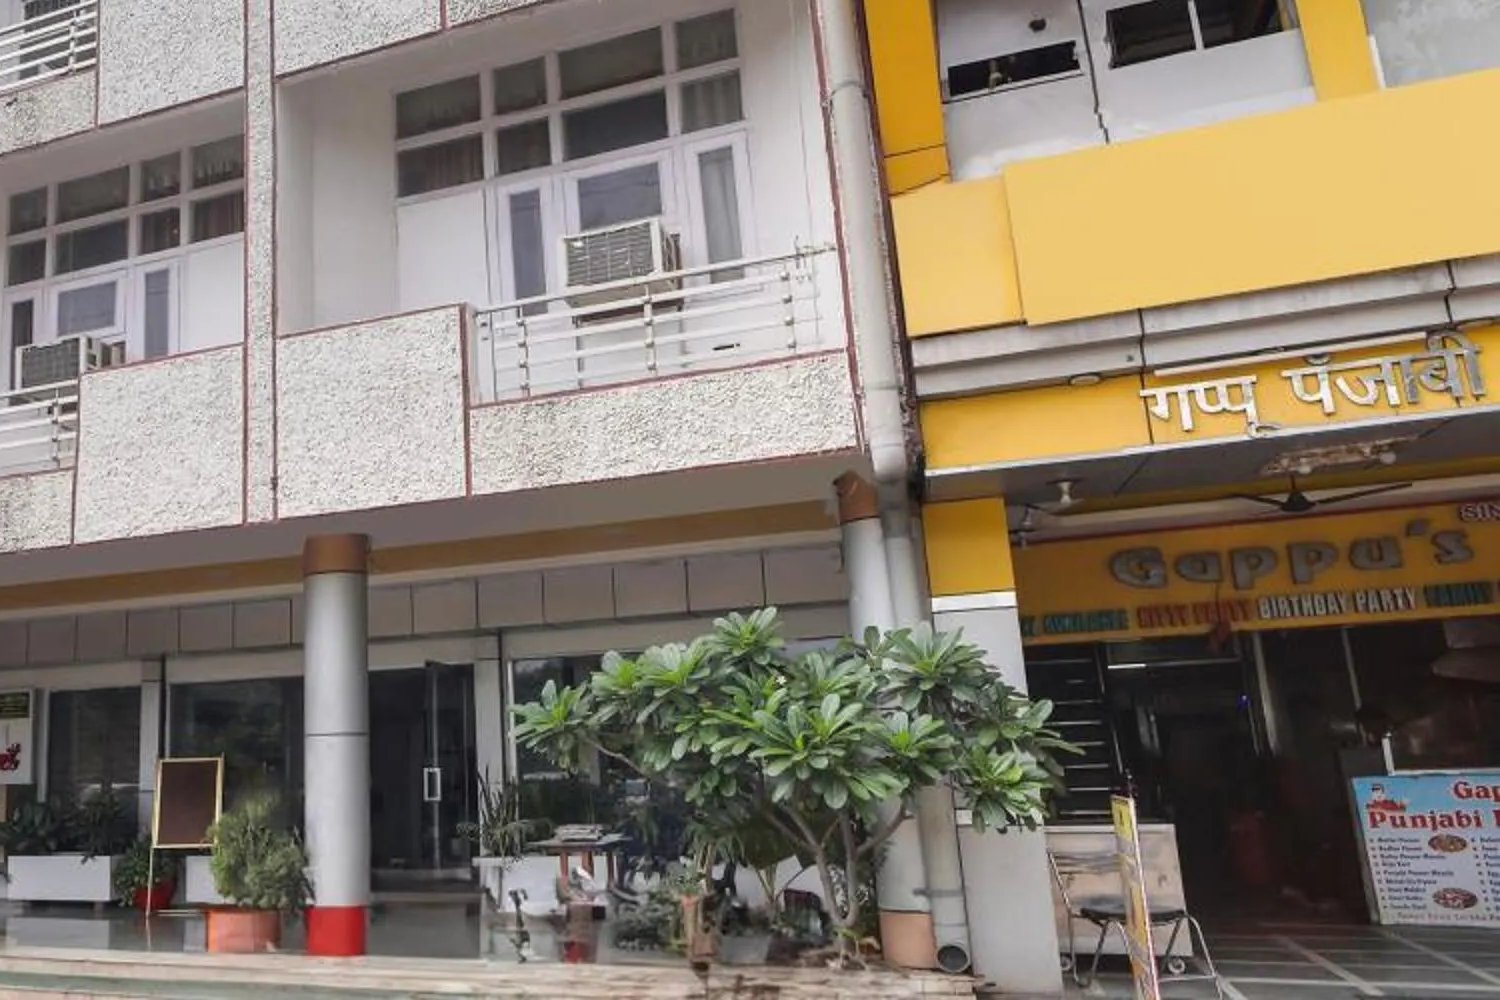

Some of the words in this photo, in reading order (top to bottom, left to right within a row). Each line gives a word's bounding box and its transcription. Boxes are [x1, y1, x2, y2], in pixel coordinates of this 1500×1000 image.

[1257, 589, 1348, 620] BIRTHDAY
[1353, 586, 1417, 613] PARTY
[1369, 809, 1482, 831] Punjabi
